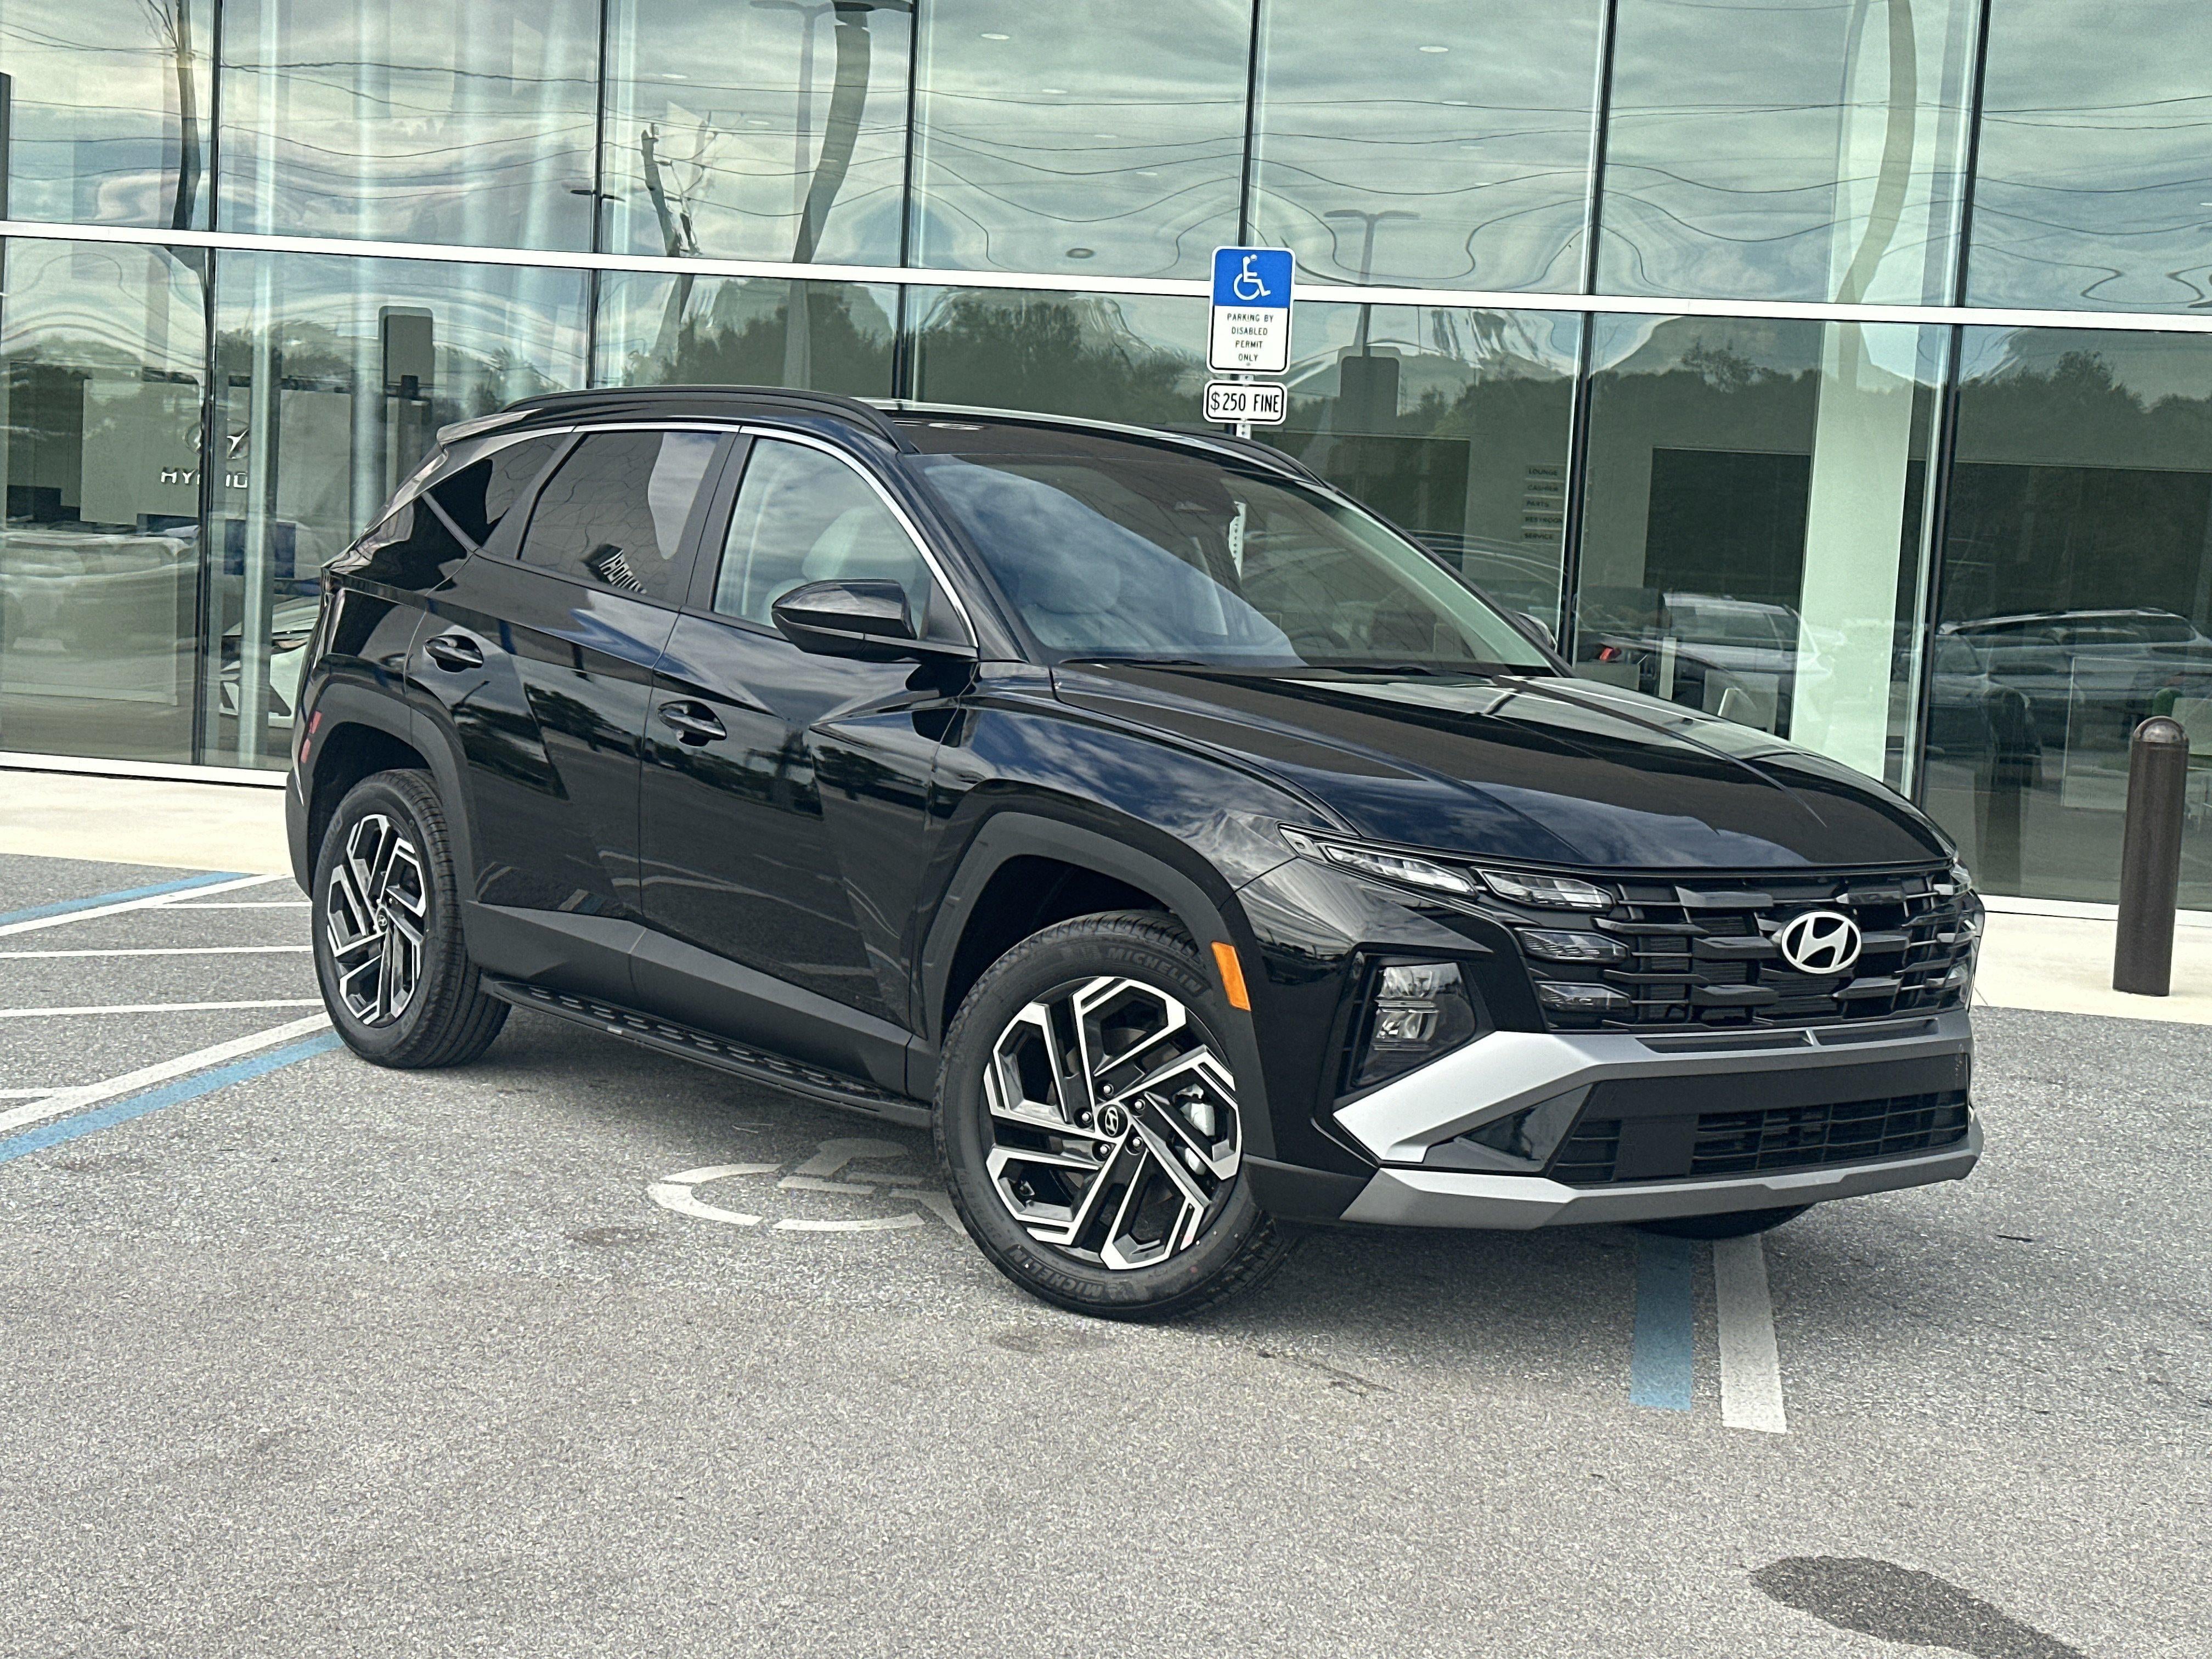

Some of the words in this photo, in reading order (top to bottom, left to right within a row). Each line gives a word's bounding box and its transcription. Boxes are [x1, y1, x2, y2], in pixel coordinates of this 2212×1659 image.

[1227, 313, 1260, 323] PARKING
[1263, 314, 1274, 323] BY
[1231, 326, 1268, 336] DISABLED
[1235, 340, 1263, 349] PERMIT
[1238, 354, 1259, 362] ONLY
[1210, 391, 1246, 413] $250
[1254, 394, 1280, 413] FINE
[1528, 468, 1558, 476] LOUNGE
[1108, 947, 1203, 992] MICHELIN
[1009, 1249, 1104, 1296] MICHELIN
